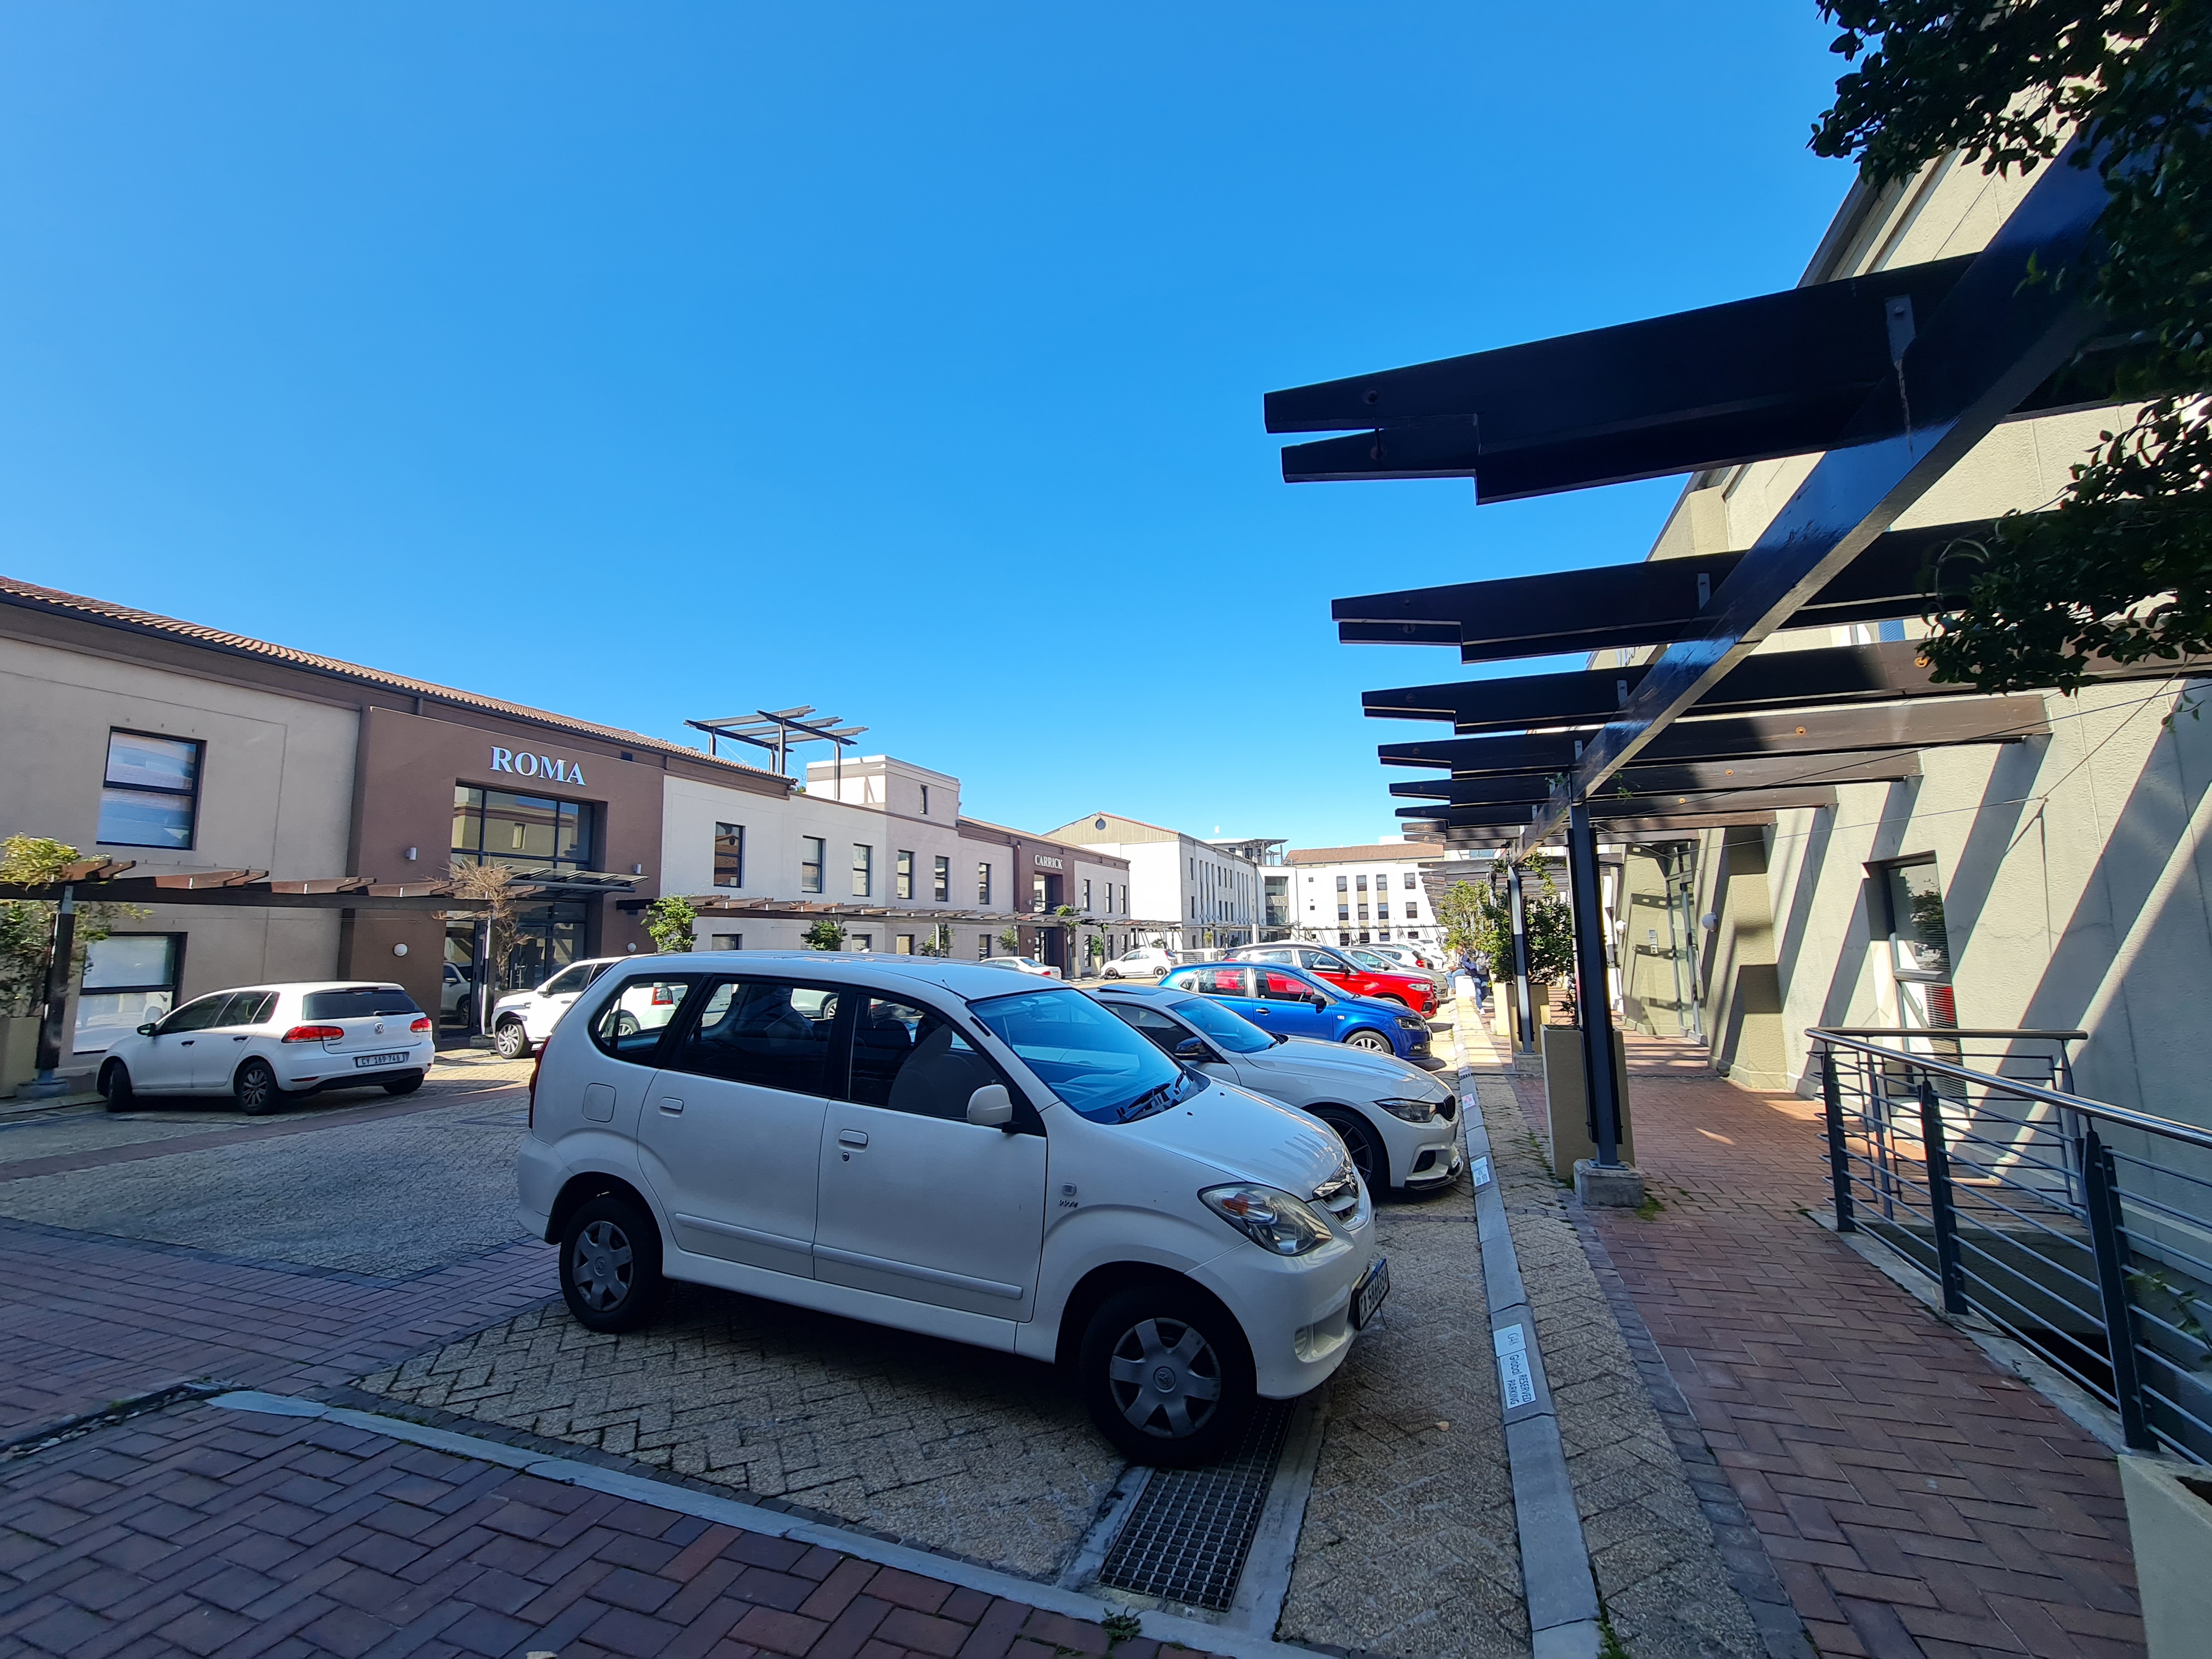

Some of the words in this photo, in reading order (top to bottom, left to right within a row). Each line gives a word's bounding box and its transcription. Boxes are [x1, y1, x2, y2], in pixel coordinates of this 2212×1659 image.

[489, 746, 586, 786] ROMA
[1035, 854, 1063, 870] CARRICK
[1361, 1294, 1367, 1321] CA
[1510, 1354, 1522, 1376] Global
[1507, 1379, 1520, 1405] PARKING
[1519, 1374, 1532, 1402] RESERVED
